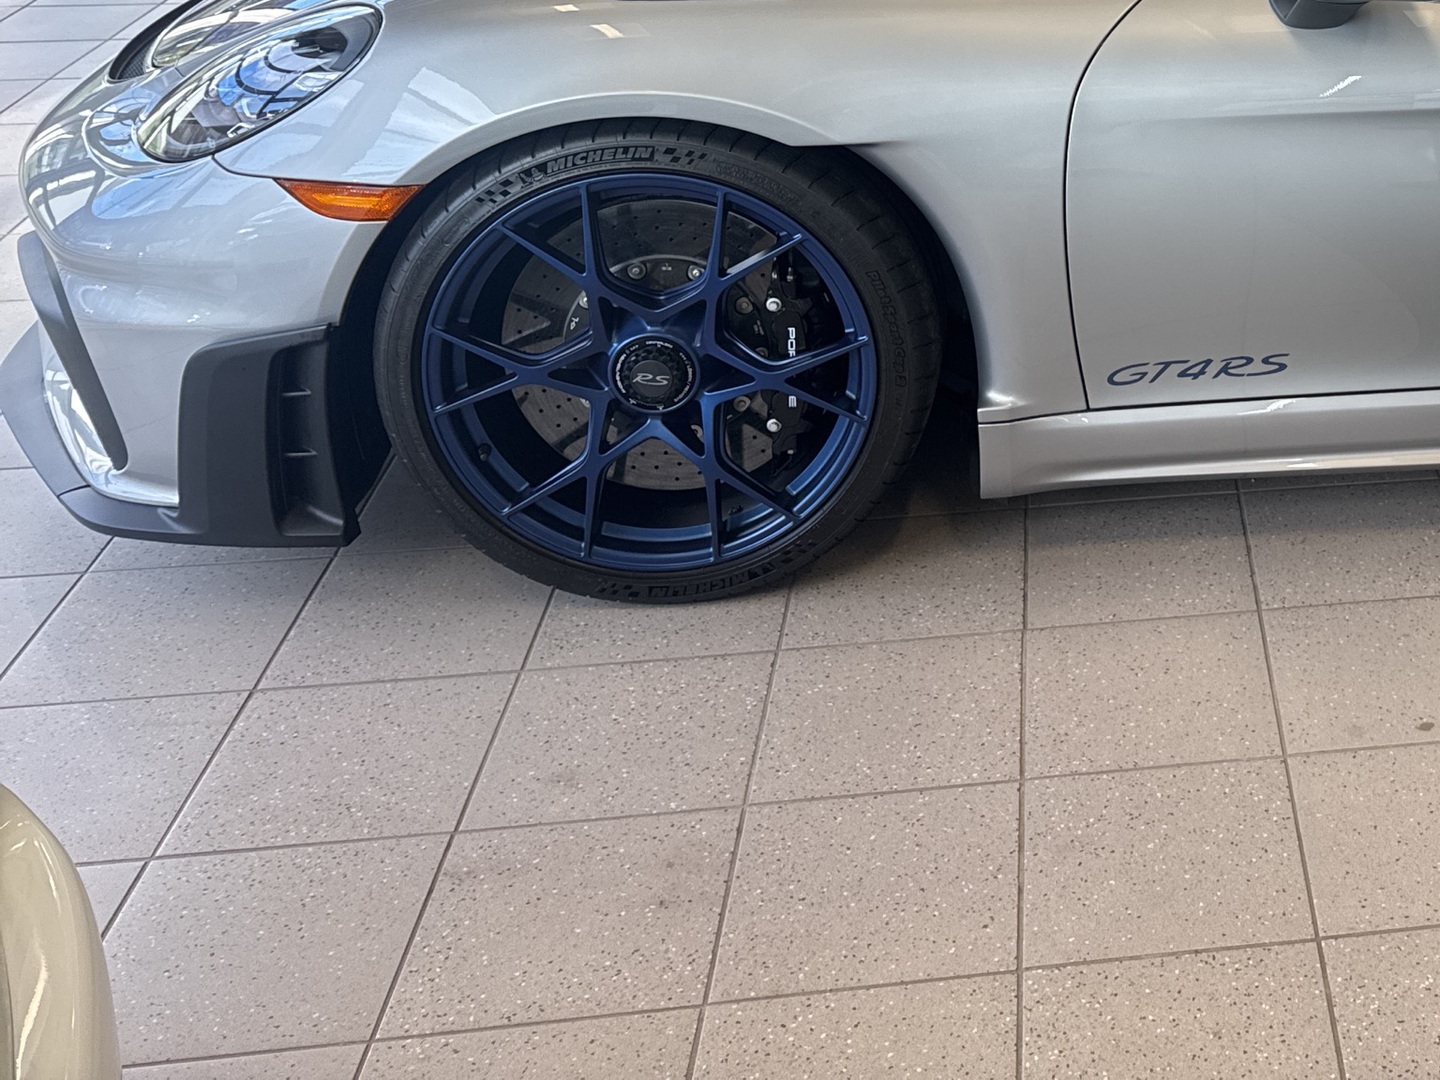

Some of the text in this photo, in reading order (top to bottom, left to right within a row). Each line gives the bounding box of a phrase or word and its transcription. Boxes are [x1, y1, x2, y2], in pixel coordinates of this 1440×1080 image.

[547, 146, 653, 175] MICHELIN
[632, 372, 671, 386] RS
[1106, 353, 1290, 387] GT4RS
